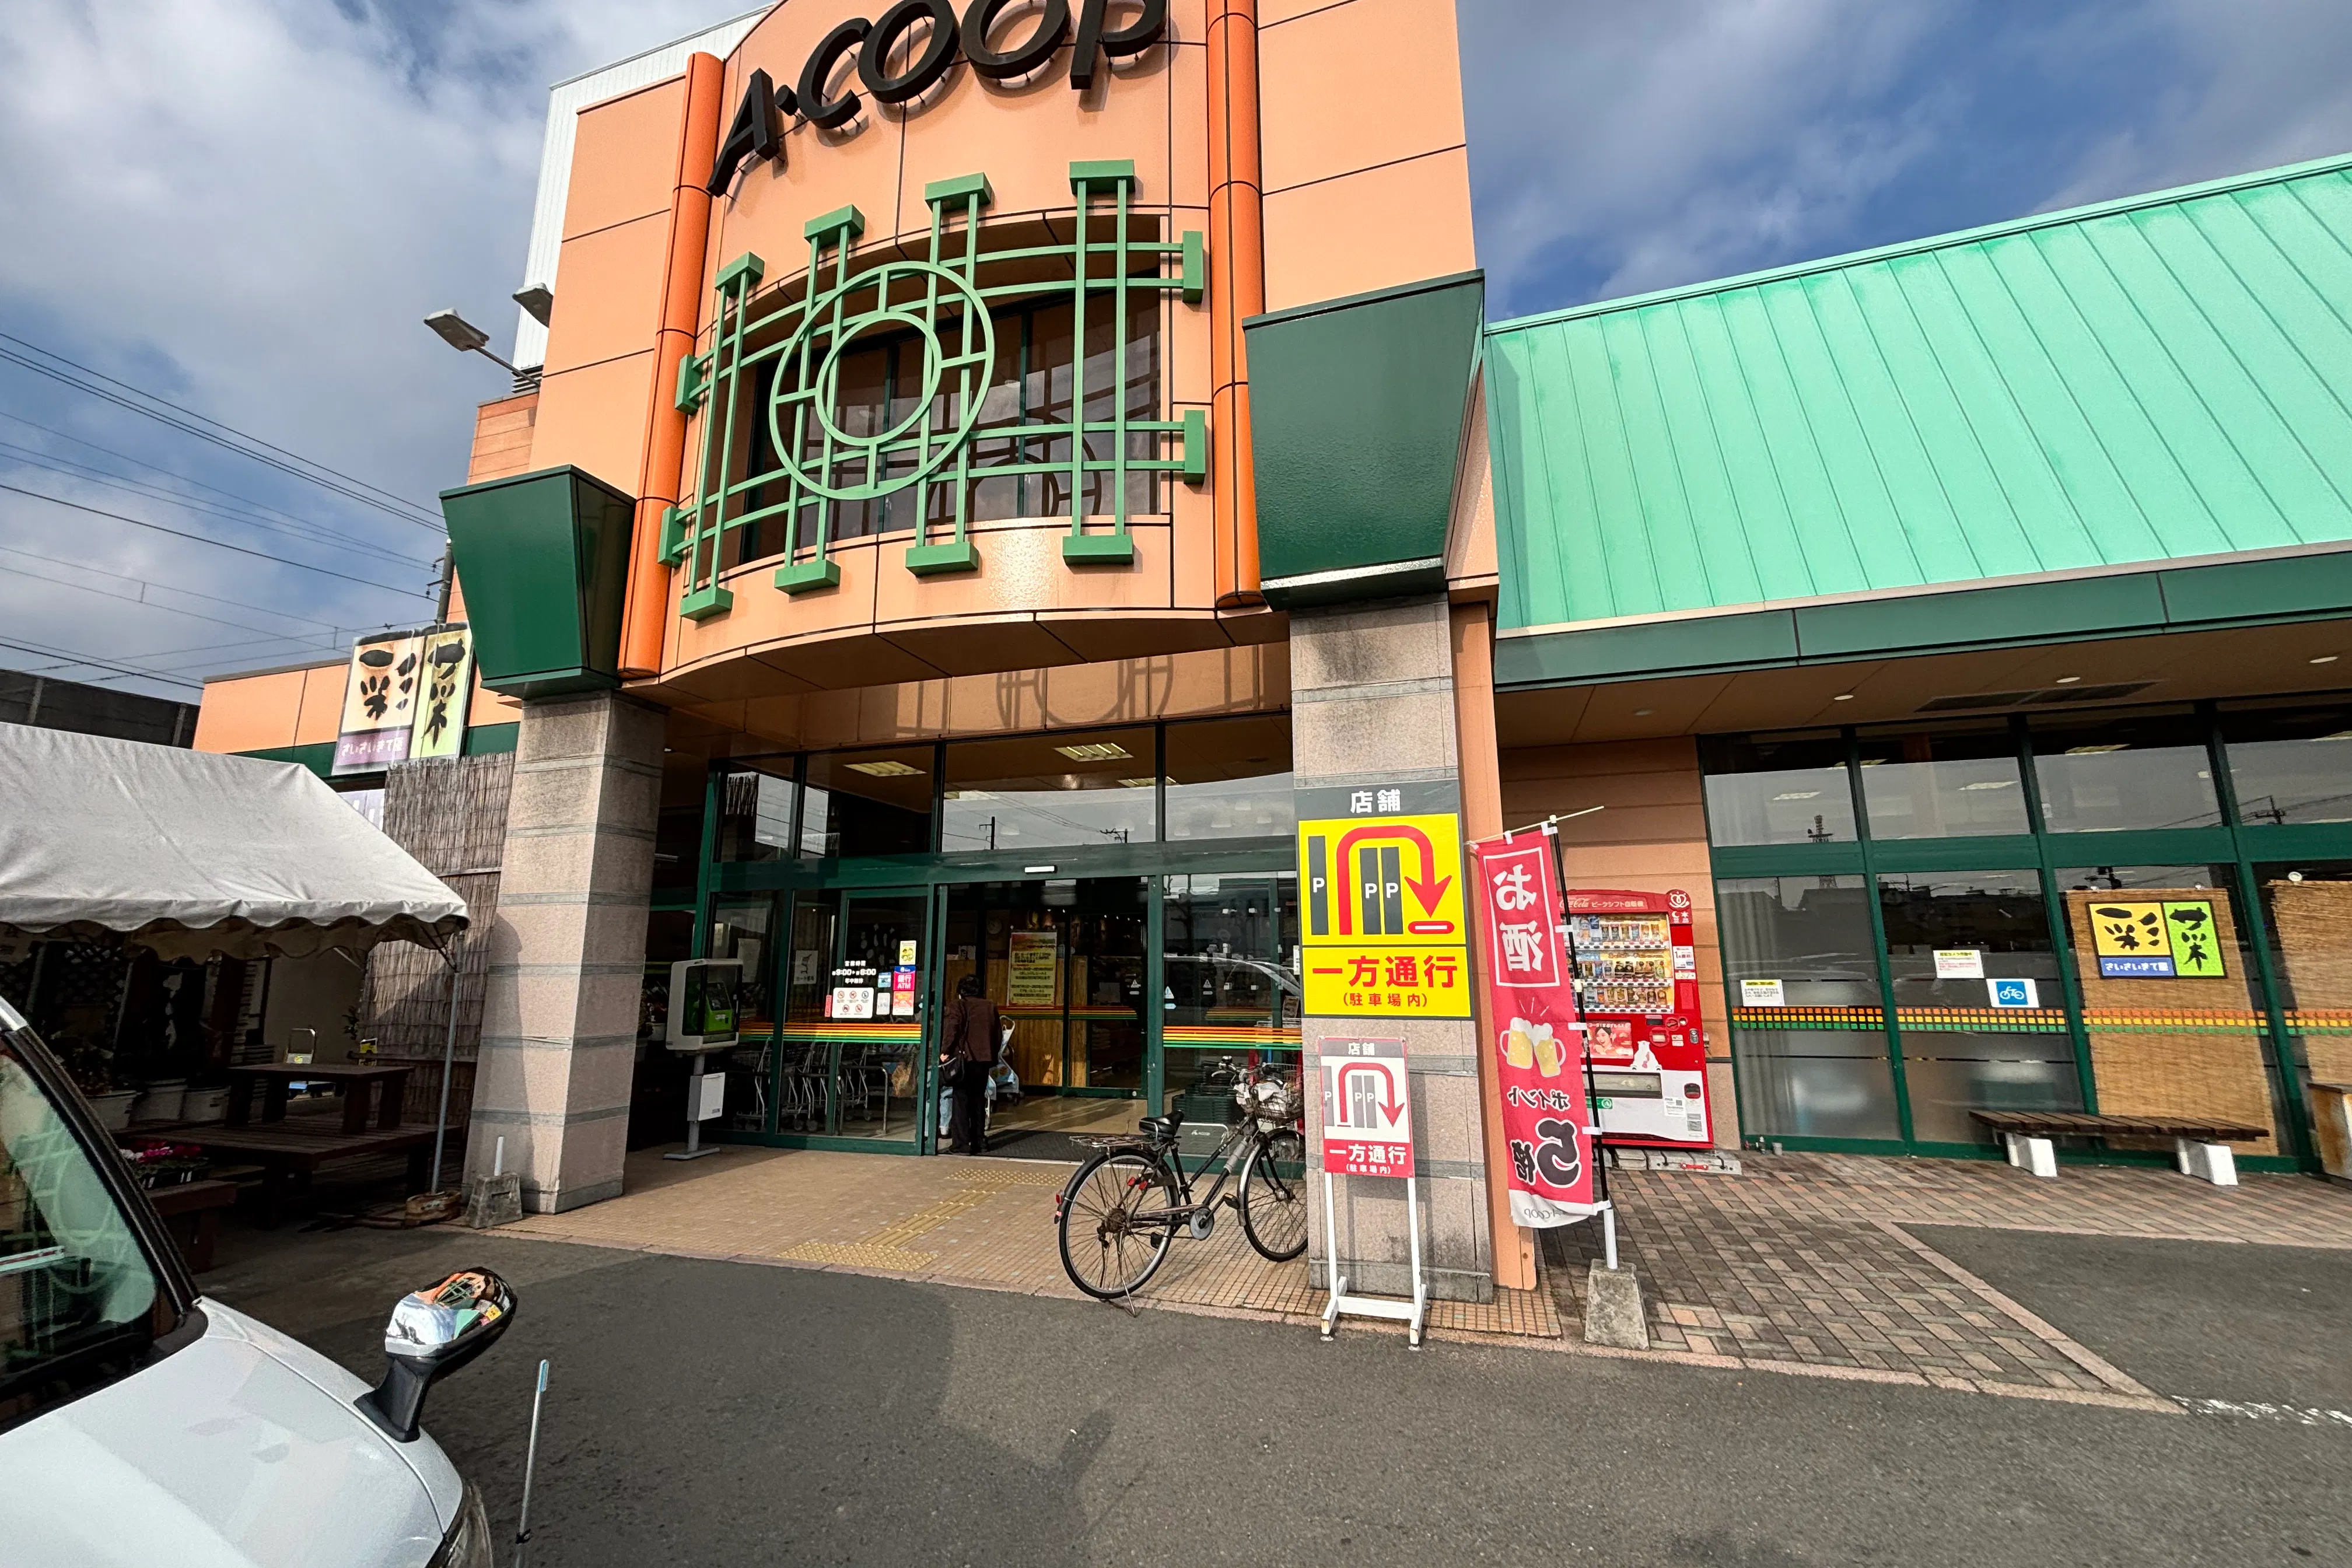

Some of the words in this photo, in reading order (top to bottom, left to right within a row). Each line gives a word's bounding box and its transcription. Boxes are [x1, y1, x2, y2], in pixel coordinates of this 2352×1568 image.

[1350, 789, 1401, 814] 店舗
[1312, 877, 1325, 893] P
[1365, 883, 1378, 899] P
[1385, 882, 1399, 898] P
[1312, 955, 1458, 989] 一方通行
[1348, 1042, 1376, 1056] 店舗
[1324, 1091, 1332, 1101] P
[1354, 1092, 1363, 1102] P
[1367, 1092, 1375, 1102] P
[1329, 1143, 1407, 1165] 一方通行
